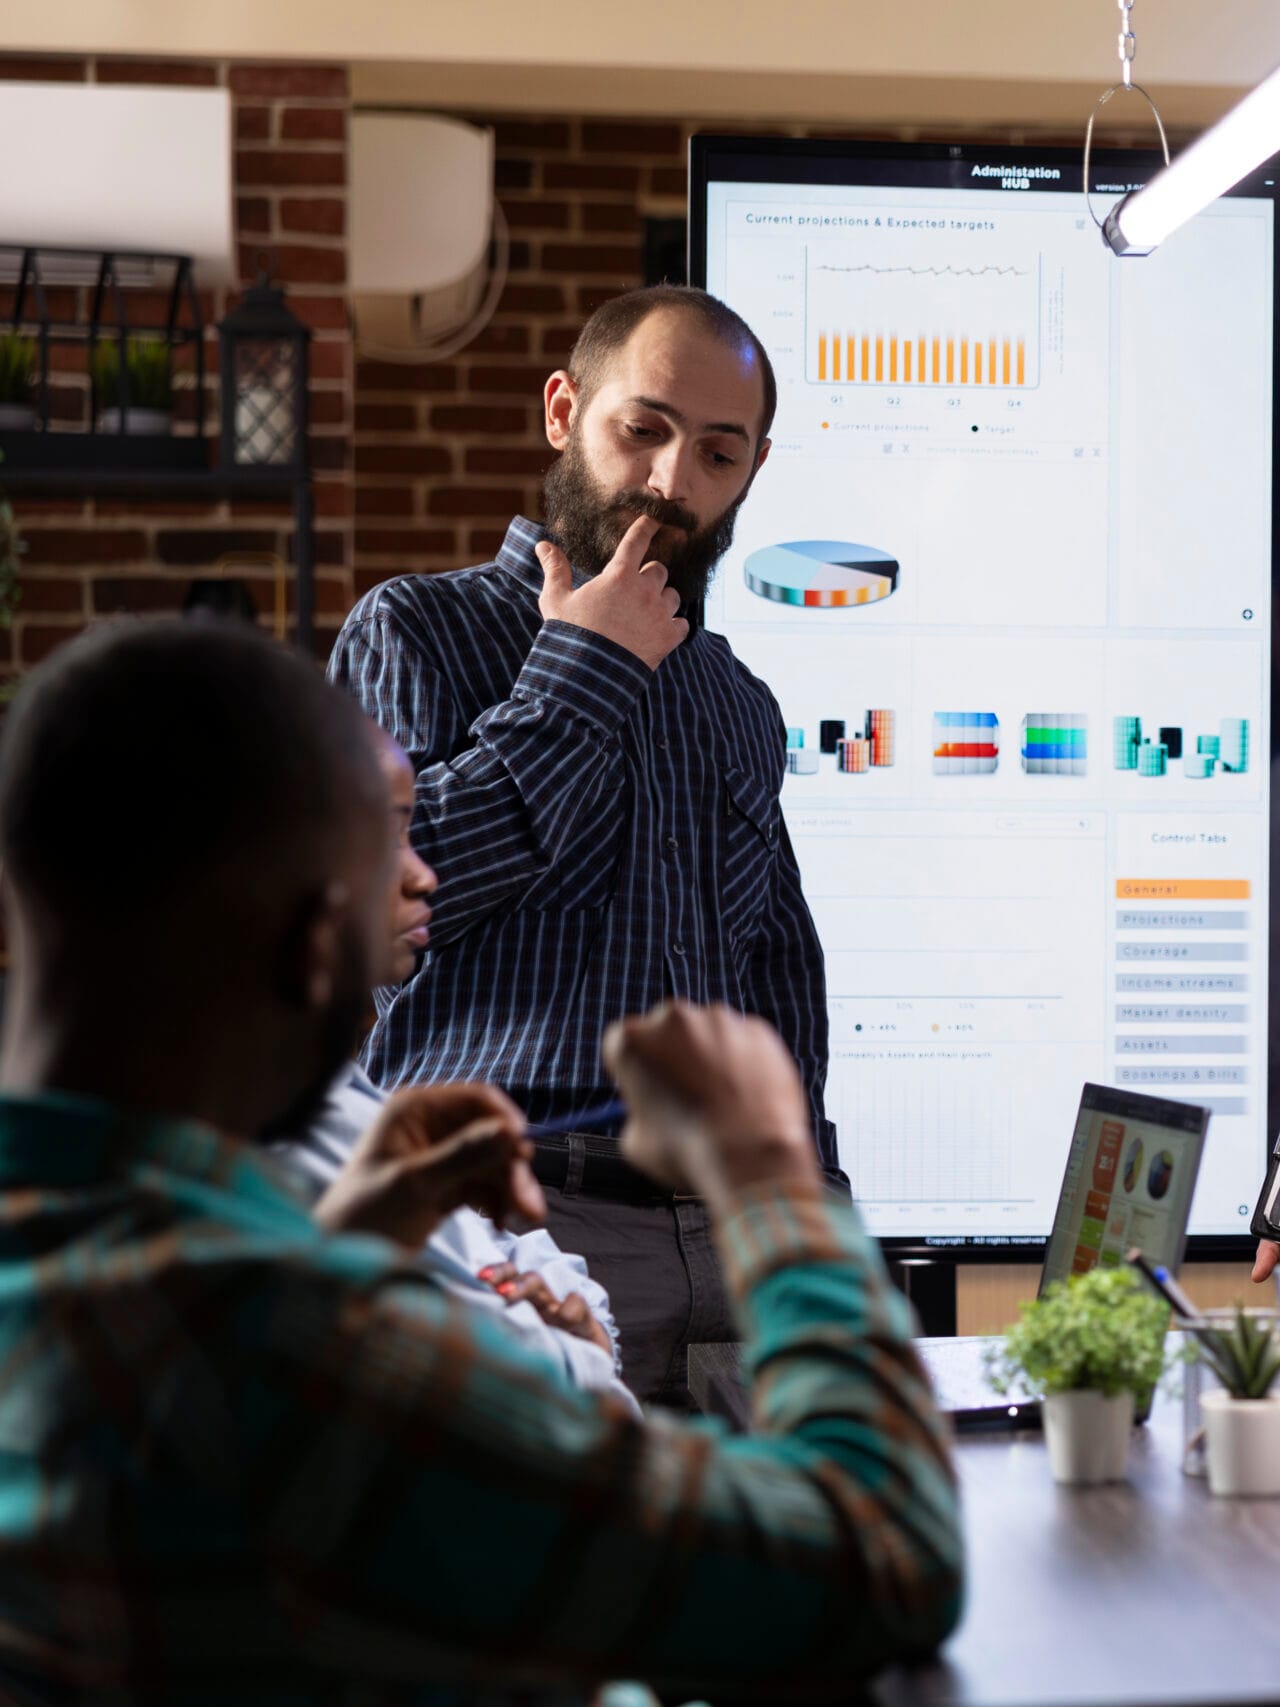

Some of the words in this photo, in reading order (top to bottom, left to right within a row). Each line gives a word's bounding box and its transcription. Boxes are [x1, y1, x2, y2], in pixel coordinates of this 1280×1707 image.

[971, 165, 1060, 180] Administation
[1002, 178, 1030, 189] HUB
[1095, 184, 1126, 192] version
[746, 213, 793, 224] Current
[798, 216, 869, 228] projections
[874, 216, 882, 226] &
[887, 217, 946, 230] Expected
[950, 218, 996, 231] targets
[1151, 833, 1196, 843] Control
[1199, 833, 1227, 843] Tabs
[1123, 884, 1179, 895] General
[1122, 914, 1204, 926] Projections
[1122, 946, 1188, 958] Coverage
[1122, 979, 1172, 988] Income
[1180, 979, 1234, 988] streams
[1121, 1008, 1169, 1018] Market
[1176, 1008, 1228, 1020] density
[1122, 1040, 1168, 1050] Assets
[1122, 1070, 1186, 1081] Bookings
[1208, 1070, 1238, 1080] Bills
[925, 1236, 966, 1246] Copyright
[973, 1236, 985, 1244] All
[986, 1236, 1010, 1246] rights
[1011, 1236, 1047, 1245] reserved
